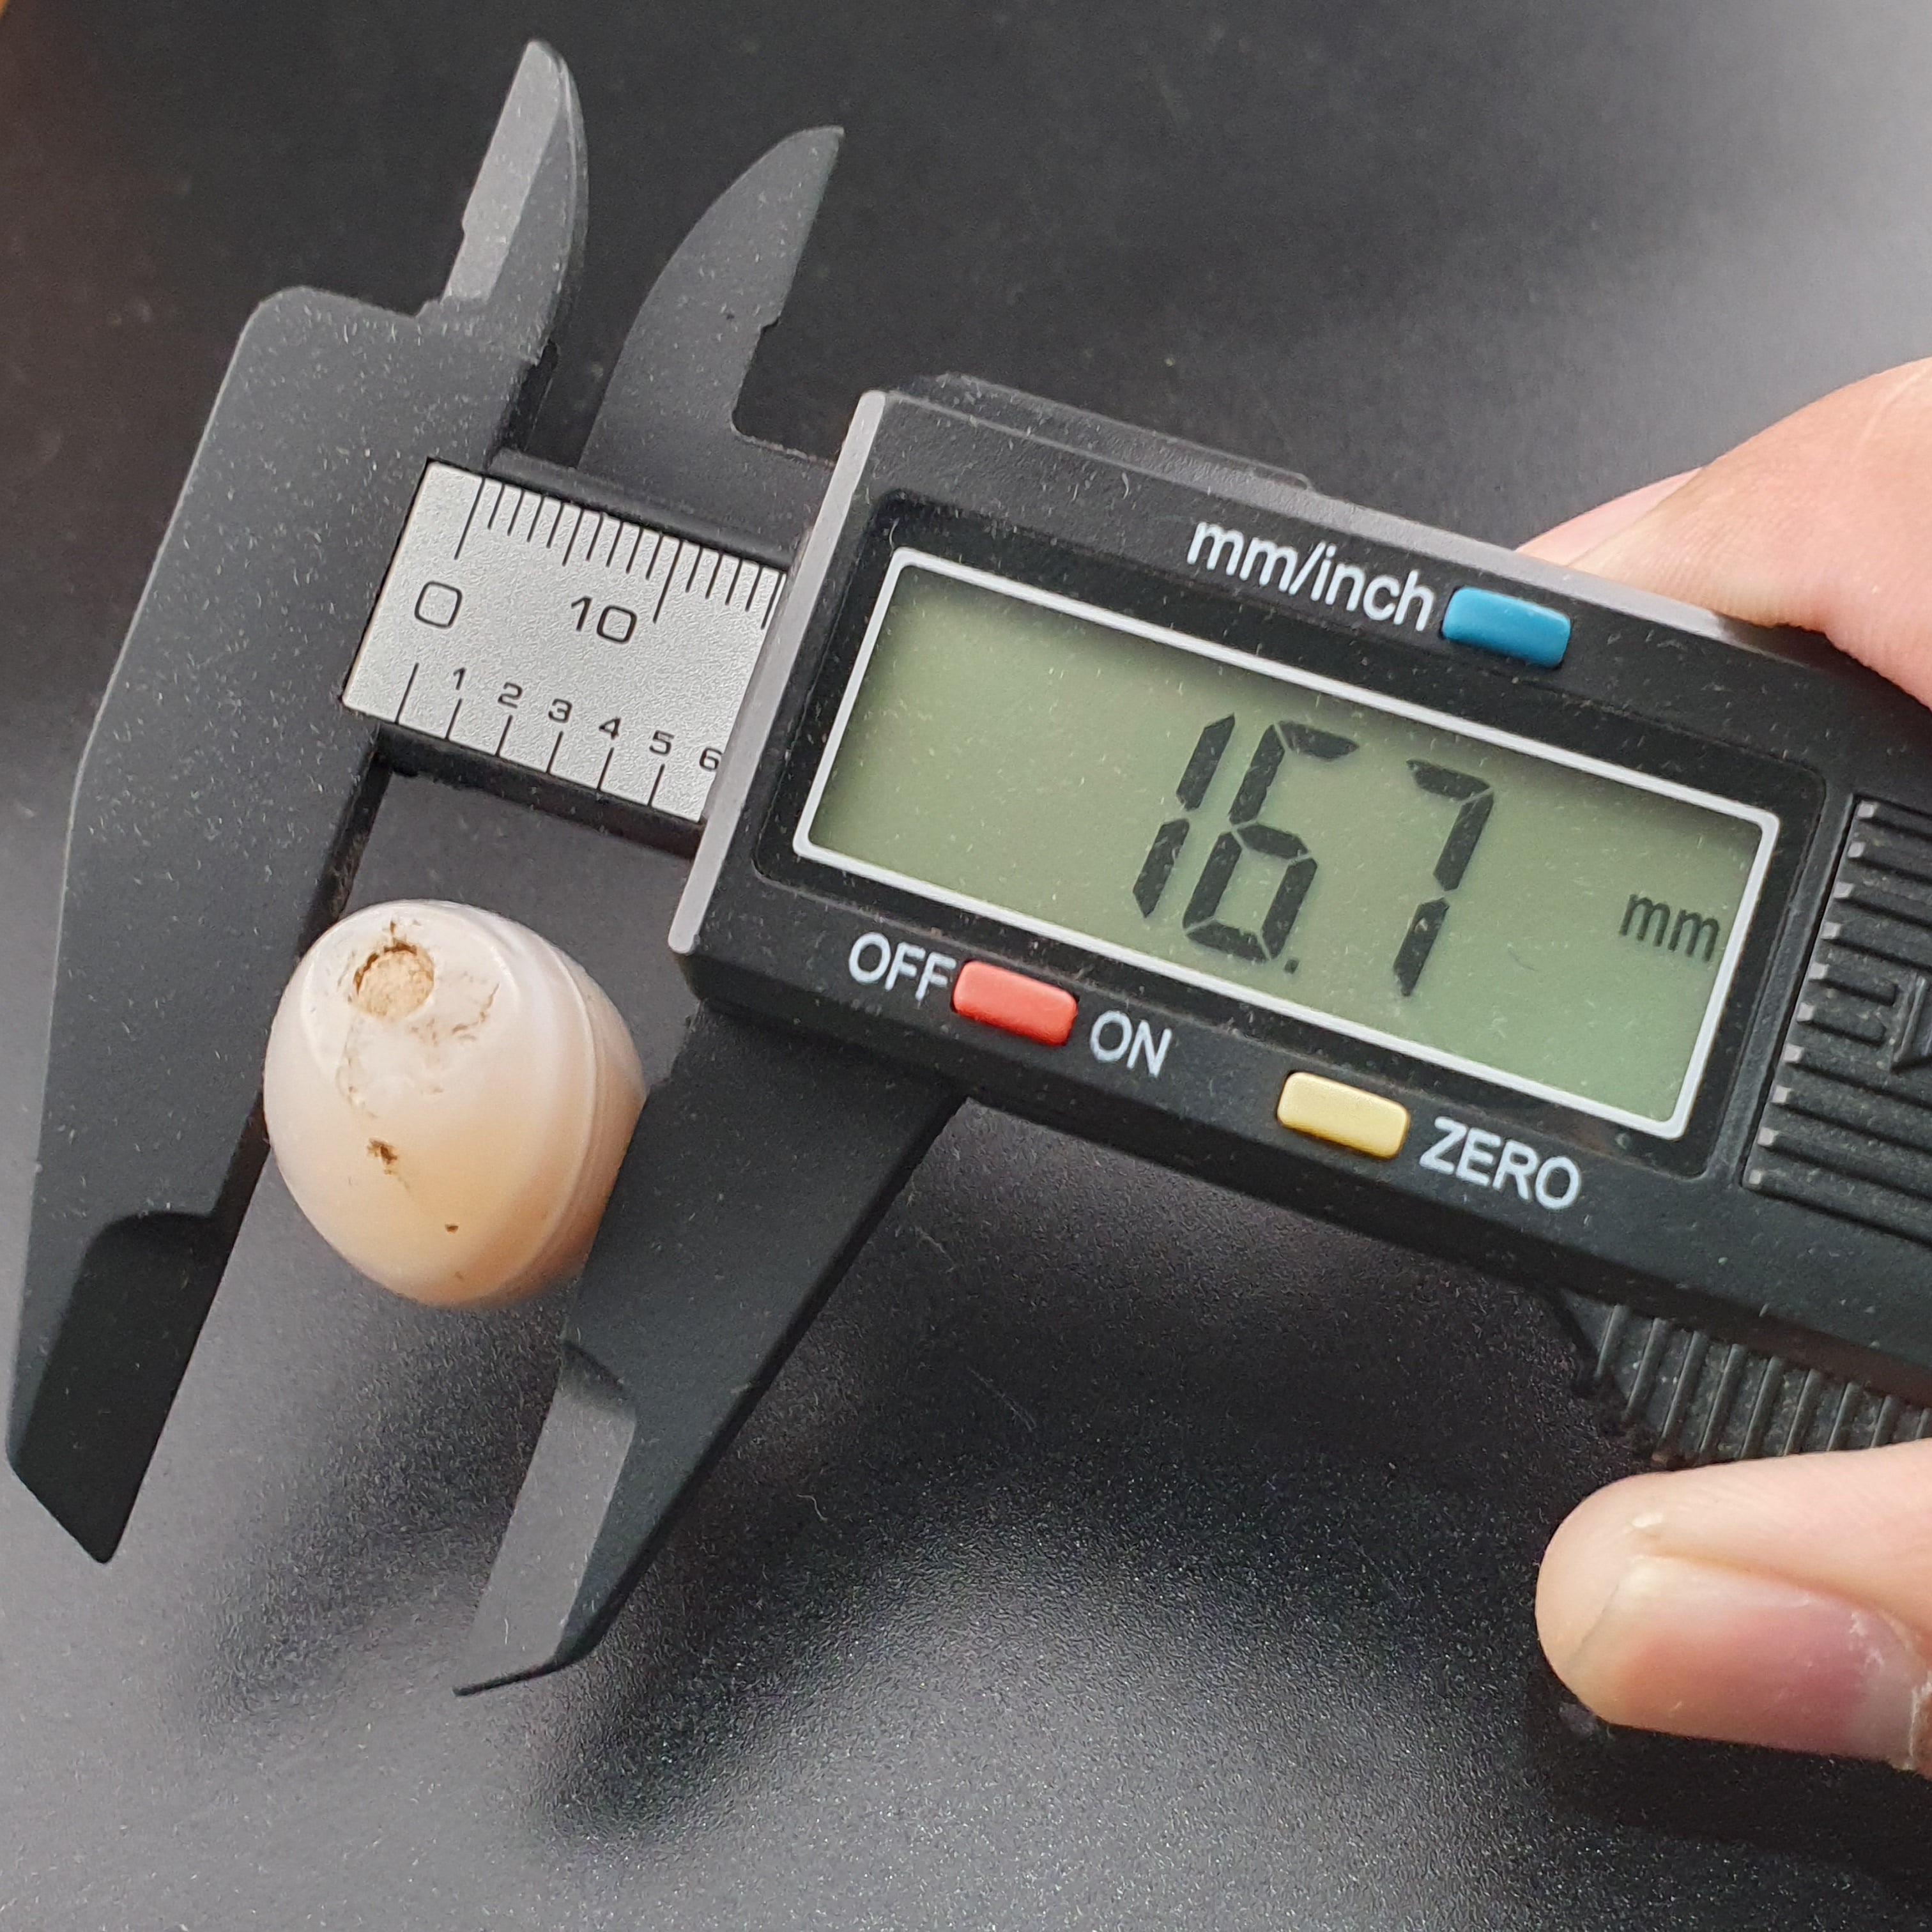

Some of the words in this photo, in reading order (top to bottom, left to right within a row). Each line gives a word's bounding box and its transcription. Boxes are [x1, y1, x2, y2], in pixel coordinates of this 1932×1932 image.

[570, 595, 638, 645] 10
[1186, 521, 1436, 632] mm/inch
[453, 667, 467, 691] 1
[498, 682, 523, 709] 2
[548, 698, 573, 724] 3
[599, 717, 621, 740] 4
[649, 729, 675, 756] 5
[699, 747, 723, 772] 6
[1619, 893, 1720, 963] mm
[848, 931, 957, 1002] OFF
[1090, 1011, 1174, 1078] ON
[1419, 1116, 1583, 1212] ZERO
